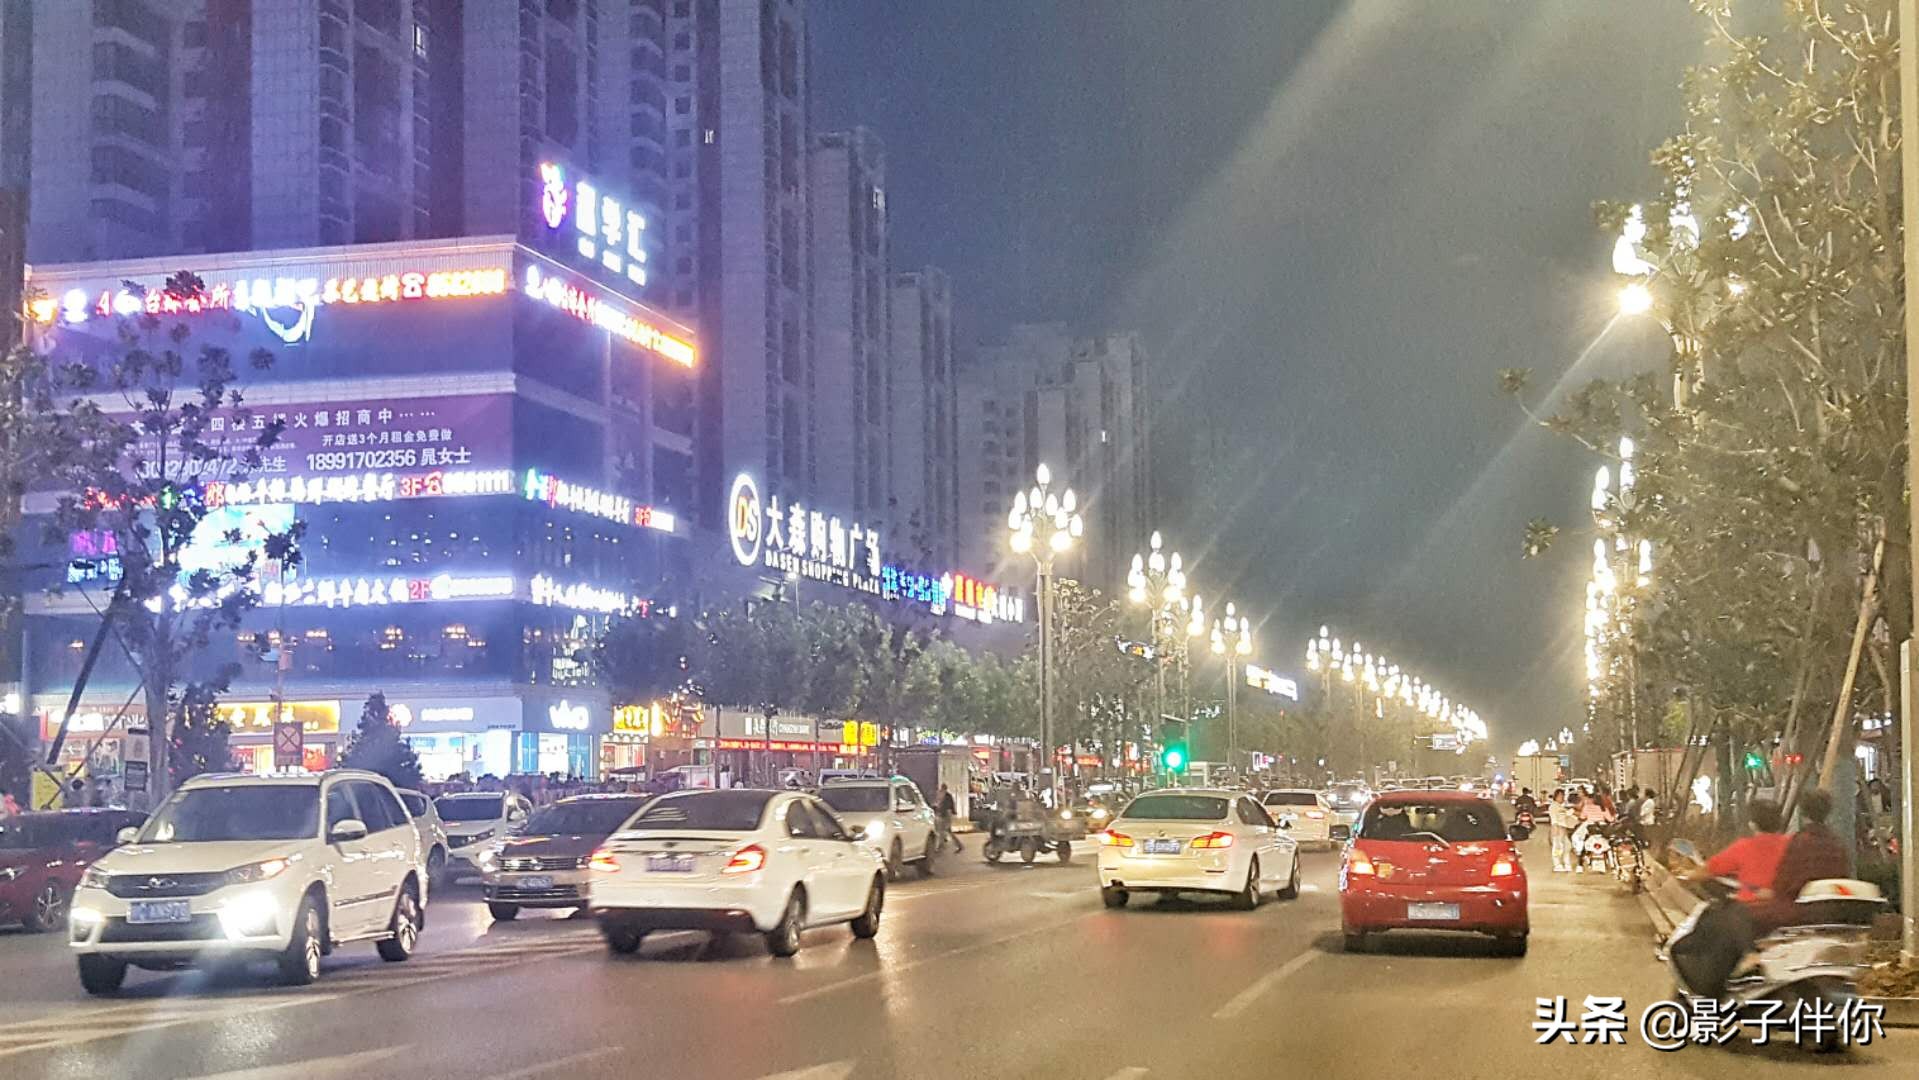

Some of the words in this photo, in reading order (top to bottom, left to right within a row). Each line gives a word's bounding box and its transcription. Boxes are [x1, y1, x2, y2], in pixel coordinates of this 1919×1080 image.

[306, 449, 416, 471] 18991702356
[400, 478, 423, 496] 3F
[765, 494, 881, 576] 大森购物广场
[765, 549, 800, 574] DASEN
[852, 572, 880, 595] PLAZA
[409, 580, 430, 599] 2F
